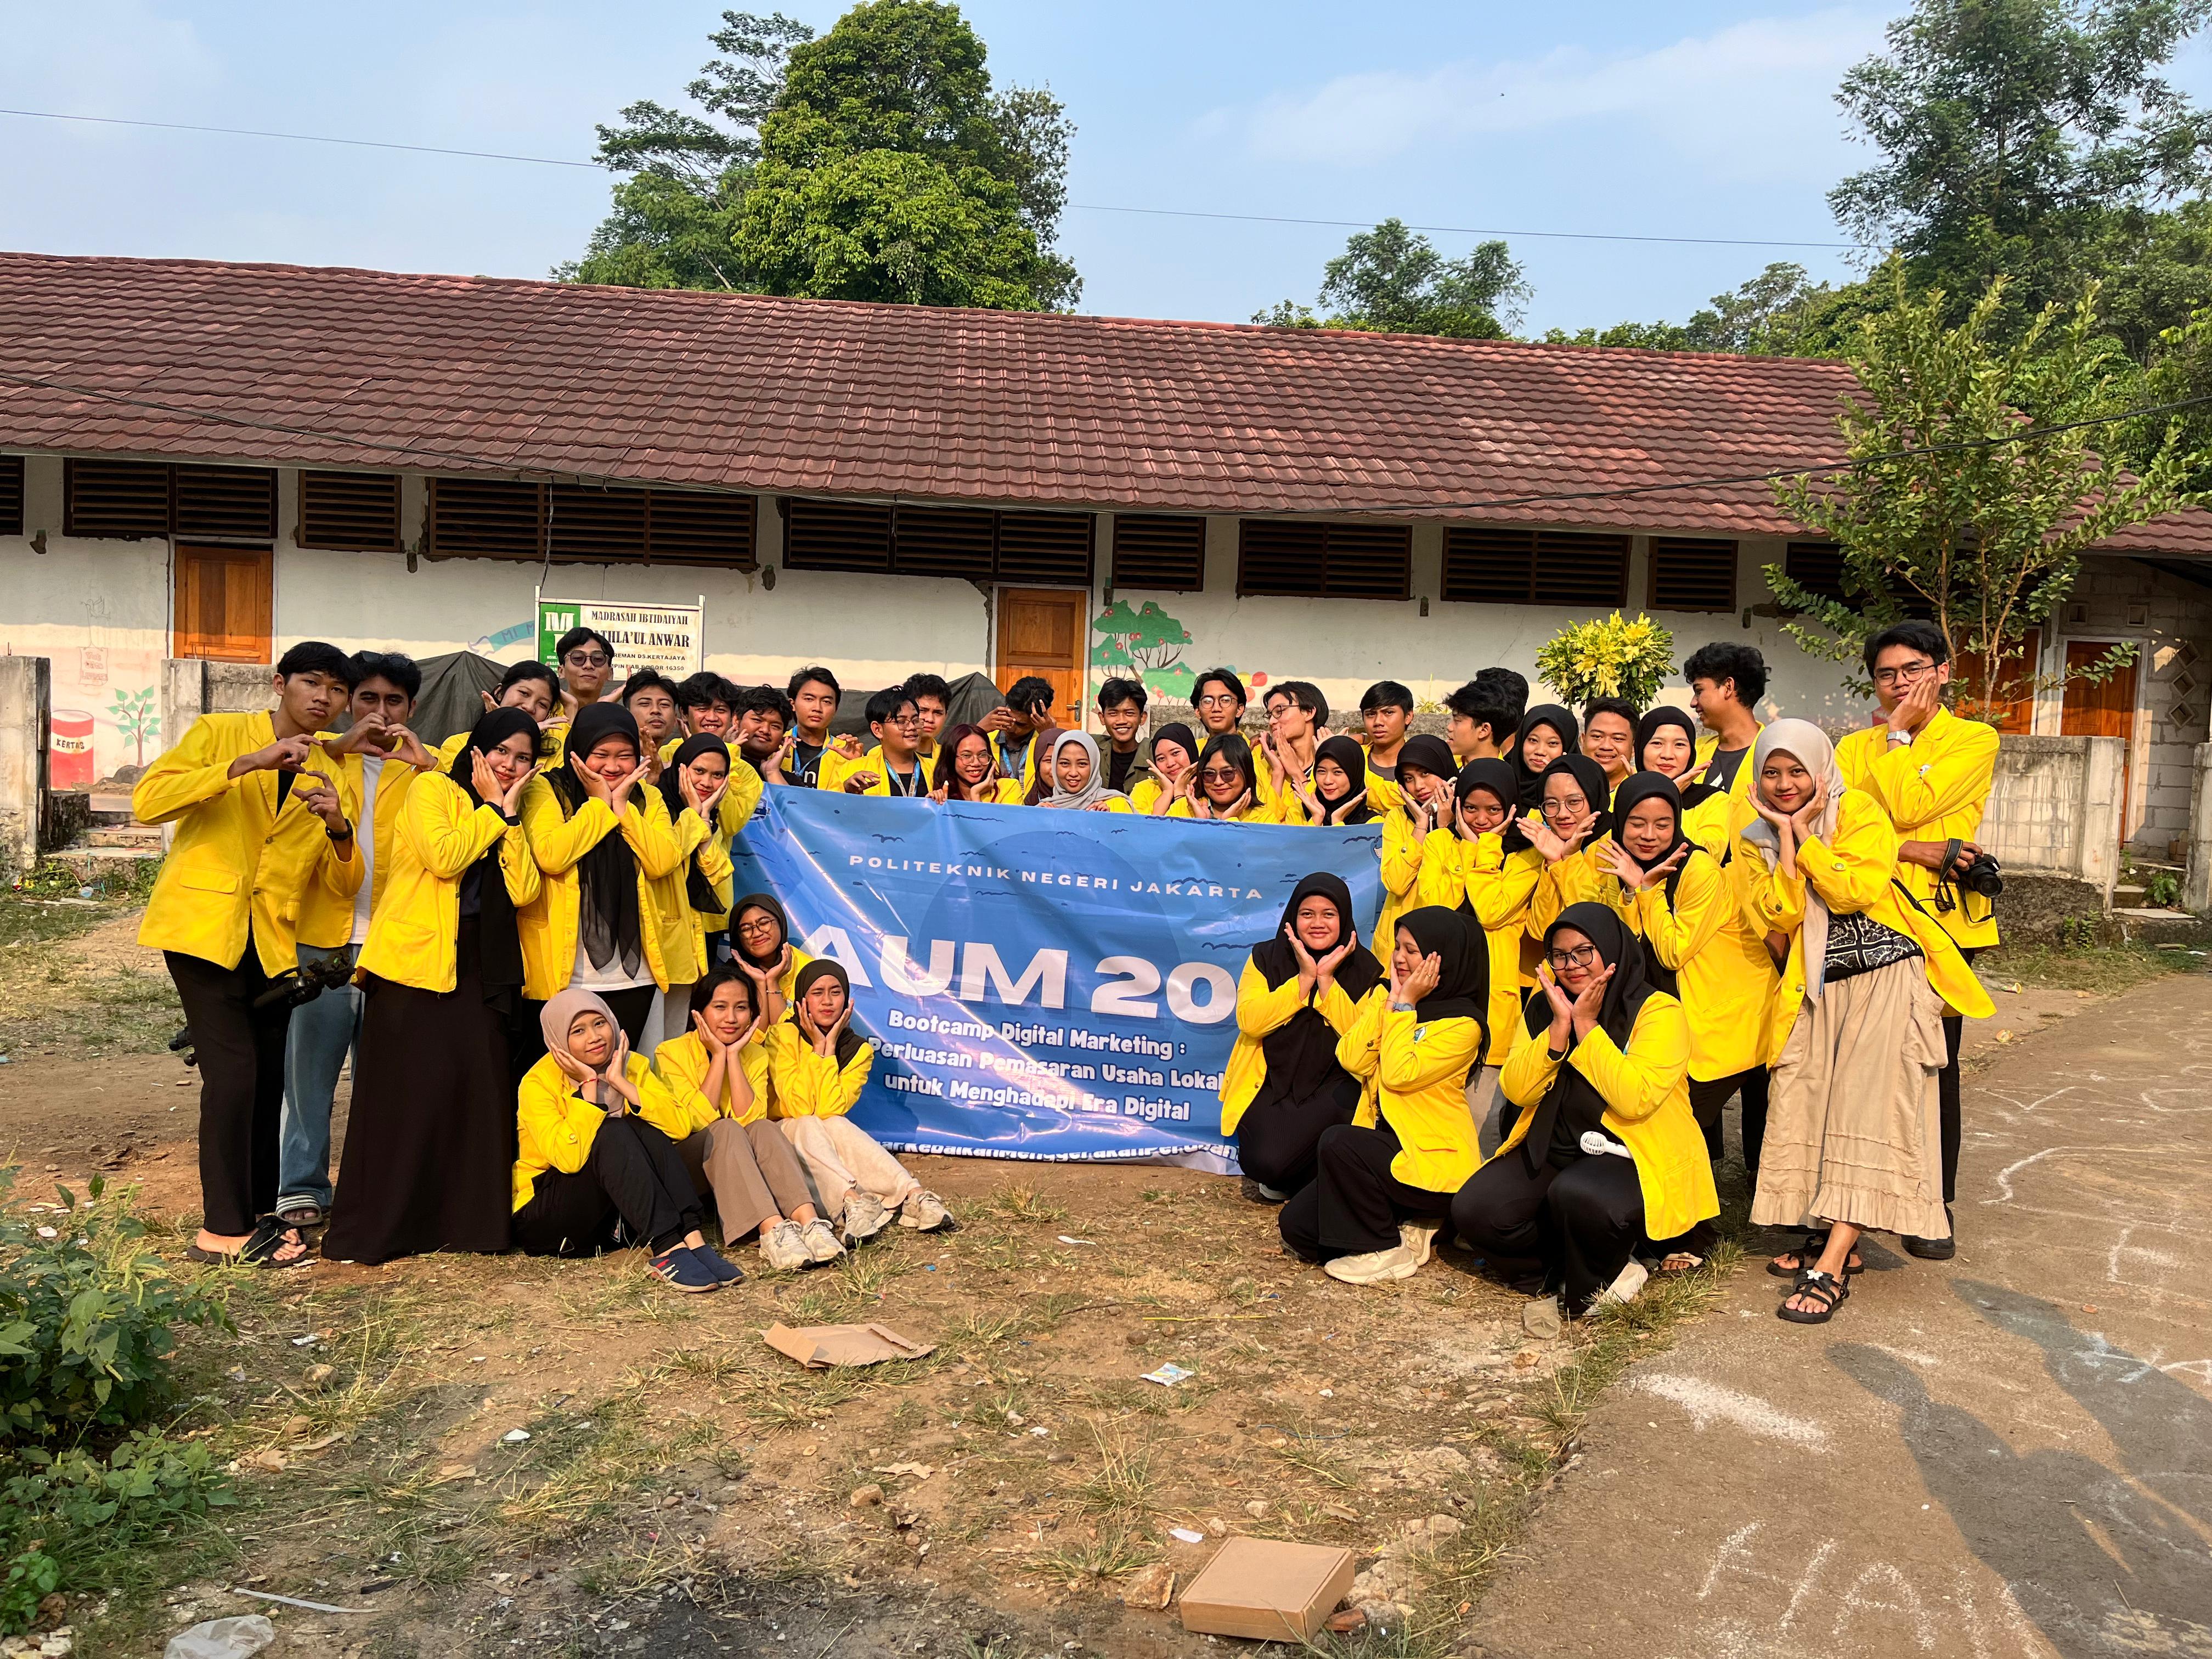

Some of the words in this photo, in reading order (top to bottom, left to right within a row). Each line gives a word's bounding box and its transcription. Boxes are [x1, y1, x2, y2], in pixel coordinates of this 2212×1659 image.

[545, 611, 574, 631] M
[591, 611, 636, 623] MADRASAH
[639, 613, 688, 625] IBTIDAIYAH
[649, 633, 690, 647] ANWAR
[56, 738, 85, 749] KERTAS
[849, 855, 1010, 880] POLITEKNIK
[1022, 870, 1118, 890] NEGERI
[1130, 881, 1263, 899] JAKARTA
[889, 1009, 994, 1040] Bootcamp
[1002, 1023, 1063, 1047] Digital
[1070, 1029, 1172, 1059] Marketing
[868, 1037, 972, 1068] Perluasan
[979, 1051, 1095, 1080] Pemasaran
[1102, 1064, 1164, 1086] Usaha
[1170, 1070, 1224, 1091] Lokal
[885, 1074, 943, 1096] untuk
[950, 1079, 1074, 1111] Menghadapi
[1082, 1094, 1118, 1114] Era
[1125, 1097, 1190, 1121] Digital
